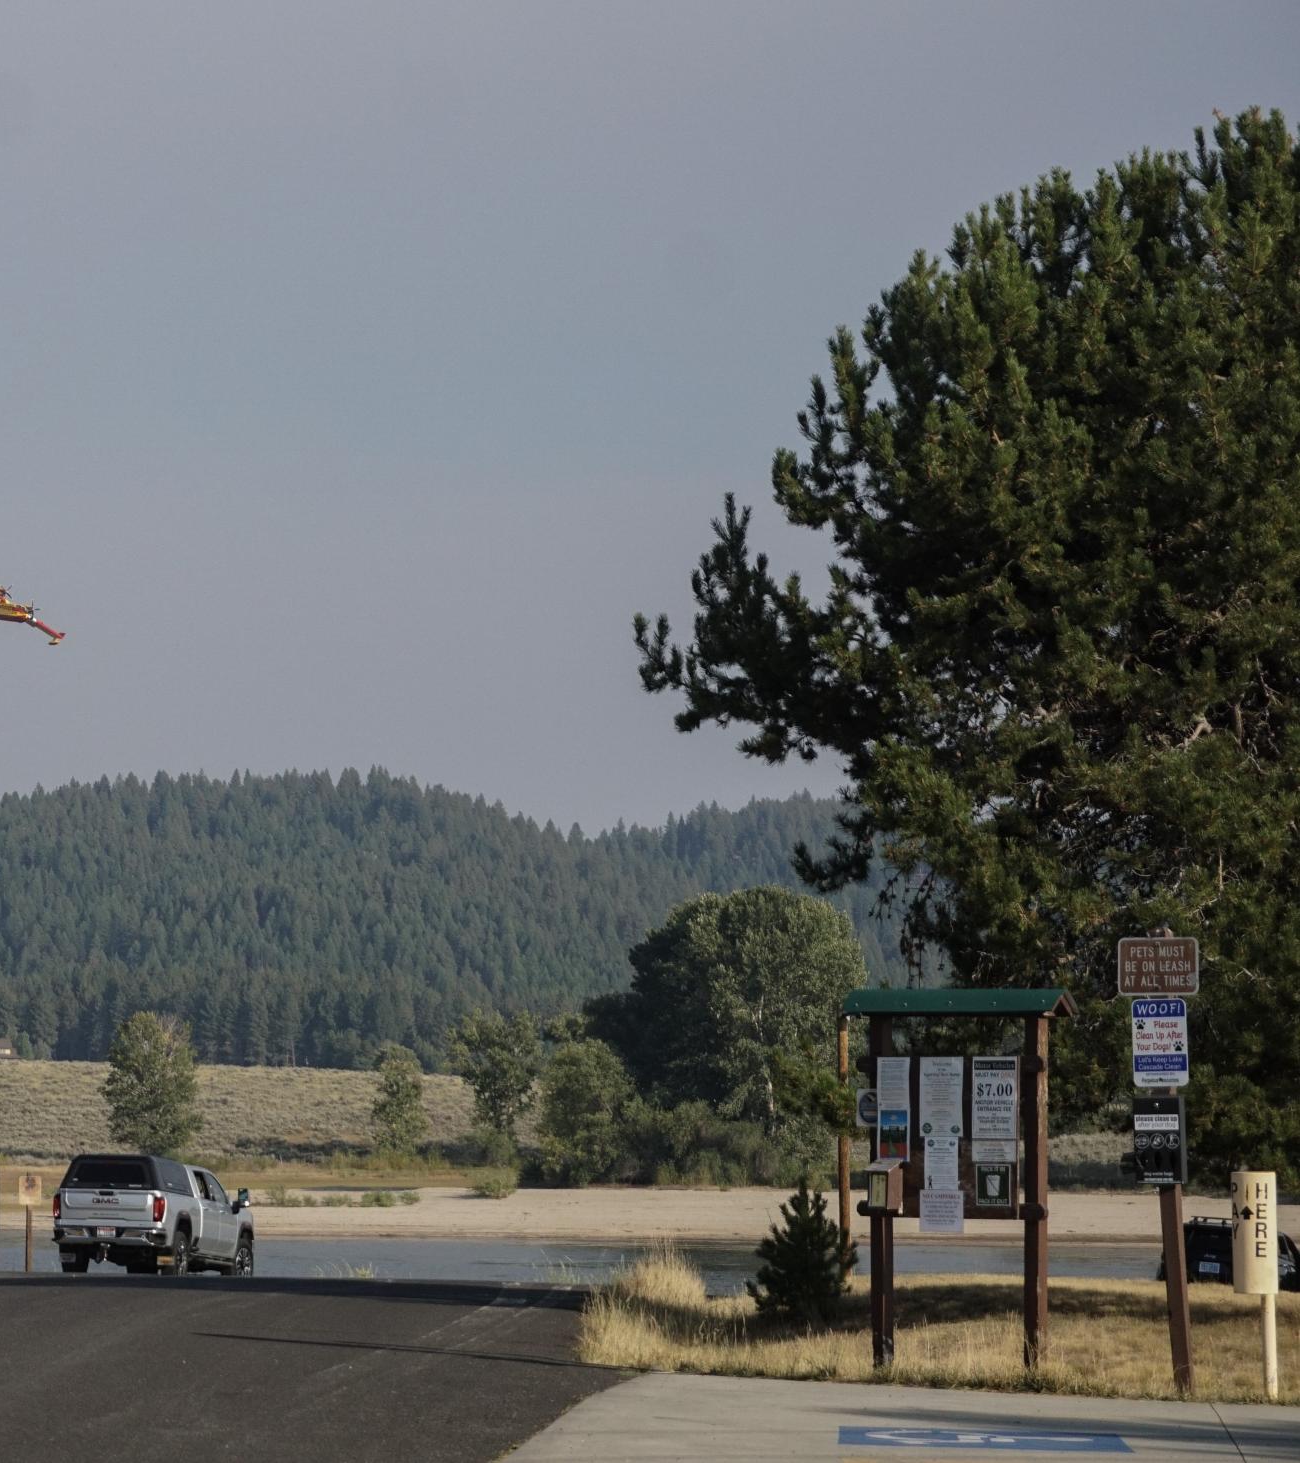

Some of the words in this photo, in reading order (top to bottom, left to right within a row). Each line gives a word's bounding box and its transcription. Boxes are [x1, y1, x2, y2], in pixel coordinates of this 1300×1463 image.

[1130, 946, 1154, 958] PETS
[1159, 946, 1184, 958] MUST
[1125, 961, 1137, 972] BE
[1142, 960, 1155, 972] ON
[1159, 960, 1191, 972] LEASH
[1124, 975, 1136, 987] AT
[1140, 975, 1159, 987] ALL
[1164, 975, 1190, 987] TIMES
[1136, 1003, 1180, 1015] WOOF!
[1153, 1020, 1178, 1028] Please
[1136, 1031, 1153, 1040] Clean
[1156, 1032, 1164, 1041] Up
[1167, 1030, 1183, 1041] After
[977, 1083, 1012, 1098] $7.00
[1255, 1182, 1268, 1258] HERE
